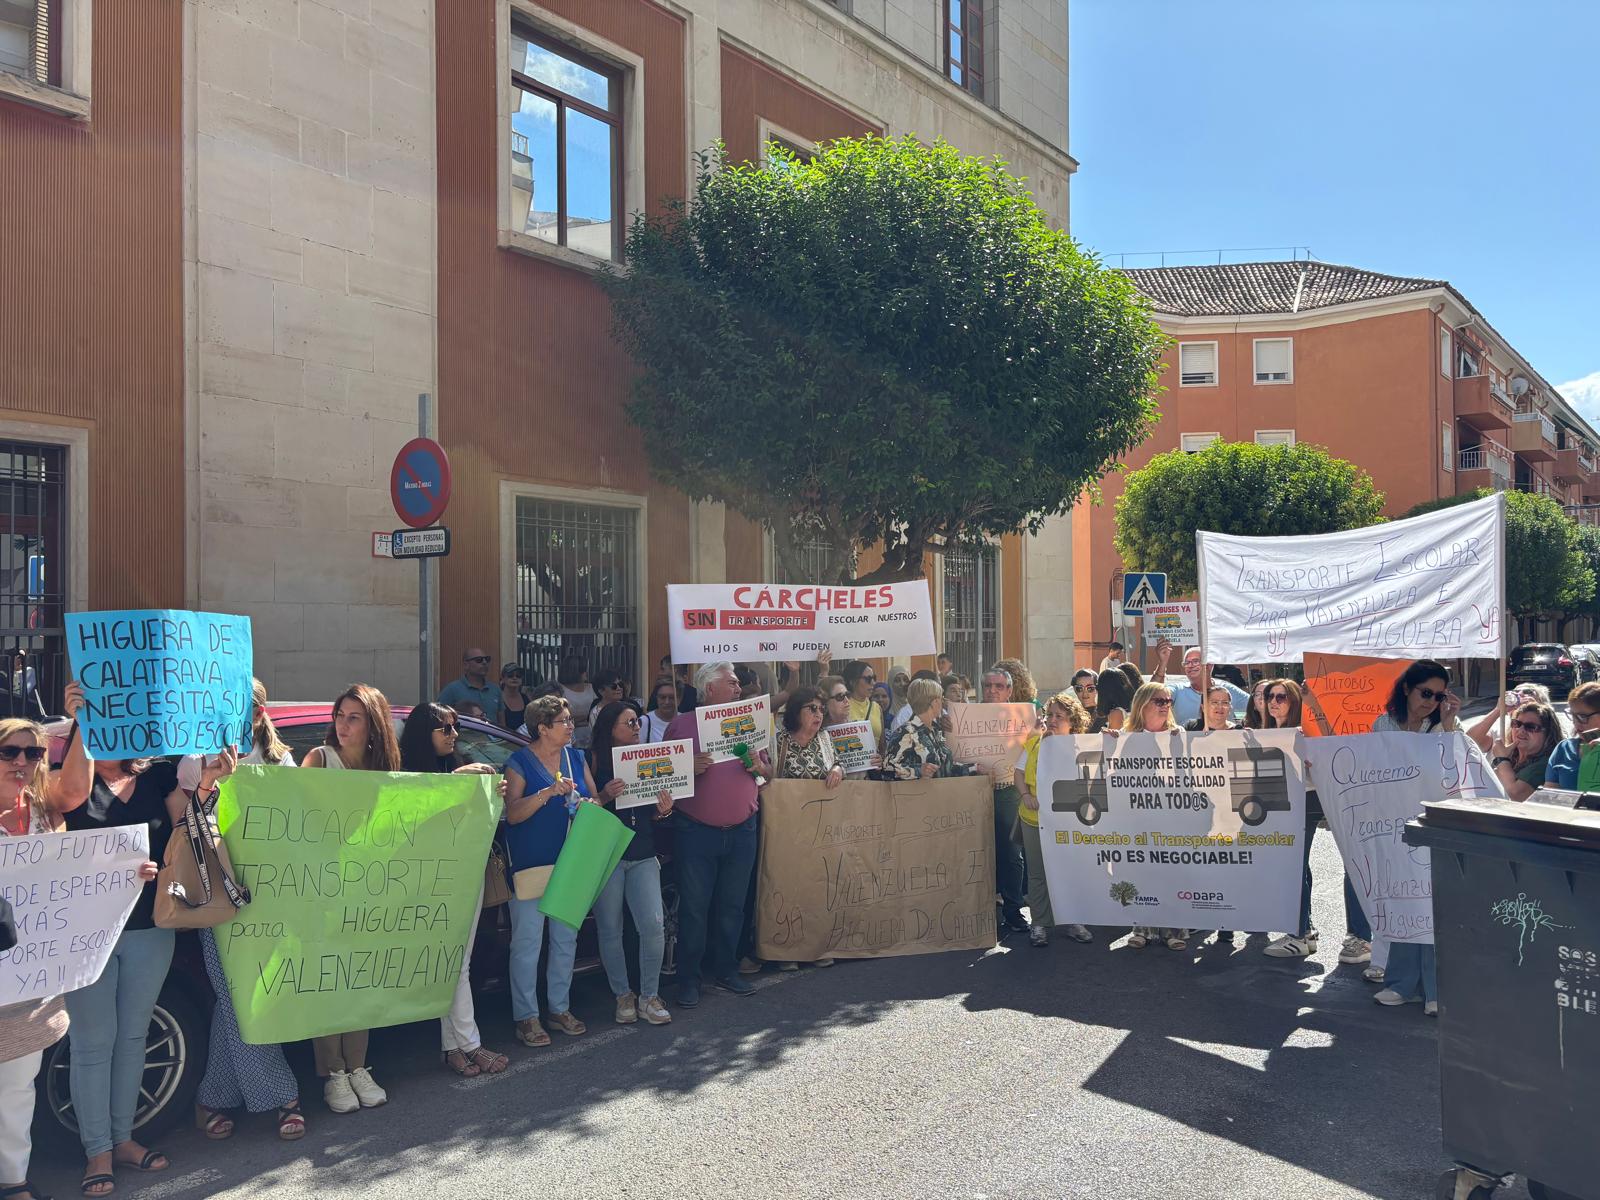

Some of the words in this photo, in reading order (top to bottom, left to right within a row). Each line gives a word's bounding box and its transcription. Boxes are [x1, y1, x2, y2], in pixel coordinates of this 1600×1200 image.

[404, 534, 421, 543] EXCEPTO
[423, 533, 444, 542] PERSONAS
[425, 544, 444, 552] REDUCIDA
[1226, 554, 1359, 591] TRANSPORTE
[1374, 534, 1481, 582] ESCOLAR
[733, 585, 894, 611] CÁRCHELES
[1146, 606, 1180, 614] AUTOBUSES
[1244, 601, 1290, 628] PARA
[1303, 585, 1416, 627] VALENZUELA
[1437, 581, 1453, 604] E
[688, 612, 715, 627] SIN
[728, 616, 808, 626] TRANSPORTE
[828, 614, 869, 624] ESCOLAR
[877, 612, 918, 623] NUESTROS
[1266, 628, 1288, 653] YA
[1353, 616, 1462, 647] HIGUERA
[1472, 604, 1500, 639] YA
[78, 618, 194, 651] HIGUERA
[209, 623, 233, 655] DE
[703, 642, 738, 654] HIJOS
[760, 642, 776, 652] NO
[792, 642, 830, 652] PUEDEN
[843, 640, 886, 649] ESTUDIAR
[80, 658, 223, 690] CALATRAVA
[1312, 656, 1375, 691] AUTOBÚS
[85, 690, 216, 722] NECESITA
[222, 690, 245, 716] SU
[705, 704, 753, 720] AUTOBUSES
[754, 701, 764, 711] YA
[1342, 694, 1382, 712] ESCOLA
[88, 716, 190, 752] AUTOBÚS
[828, 726, 858, 737] TOBUSES
[858, 725, 868, 733] YA
[953, 704, 1028, 735] VALENZUELA
[1327, 713, 1374, 736] VALEN
[726, 736, 748, 744] AUTOBUS
[748, 730, 766, 739] ESCOLAR
[954, 742, 1006, 758] NECESITA
[621, 746, 671, 762] AUTOBUSES
[673, 744, 685, 754] YA
[1106, 757, 1172, 770] TRANSPORTE
[1175, 756, 1224, 769] ESCOLAR
[1332, 746, 1421, 785] Queremos
[1438, 743, 1486, 790] YA
[630, 787, 652, 795] HIGUERA
[660, 781, 688, 789] CALATRAVA
[641, 778, 664, 787] AUTOBUS
[1111, 773, 1167, 788] EDUCACIÓN
[1169, 777, 1181, 788] DE
[1183, 775, 1226, 788] CALIDAD
[1130, 793, 1163, 810] PARA
[1165, 792, 1208, 812] TOD@S
[242, 793, 419, 848] EDUCACIÓN
[449, 813, 464, 847] Y
[801, 796, 882, 846] TRANSPORTE
[892, 792, 976, 838] ESCOLAR
[0, 840, 44, 867] TRO
[57, 831, 142, 861] FUTURO
[1055, 830, 1070, 844] El
[1073, 831, 1131, 845] Derecho
[1135, 832, 1148, 845] al
[1152, 832, 1233, 848] Transporte
[1237, 832, 1295, 846] Escolar
[1097, 850, 1122, 866] ¡NO
[1127, 850, 1145, 863] ES
[1150, 851, 1252, 865] NEGOCIABLE!
[50, 869, 136, 902] ESPERAR
[235, 858, 458, 898] TRANSPORTE
[822, 852, 949, 912] VALENZUELA
[1352, 855, 1432, 899] Valenzu
[14, 905, 68, 935] MÁS
[342, 901, 450, 933] HIGUERA
[1372, 902, 1433, 937] Higuer
[0, 940, 58, 966] PORTE
[70, 927, 121, 953] ESCOLA
[227, 921, 288, 954] para
[16, 968, 48, 994] YA
[258, 945, 430, 996] VALENZUELA
